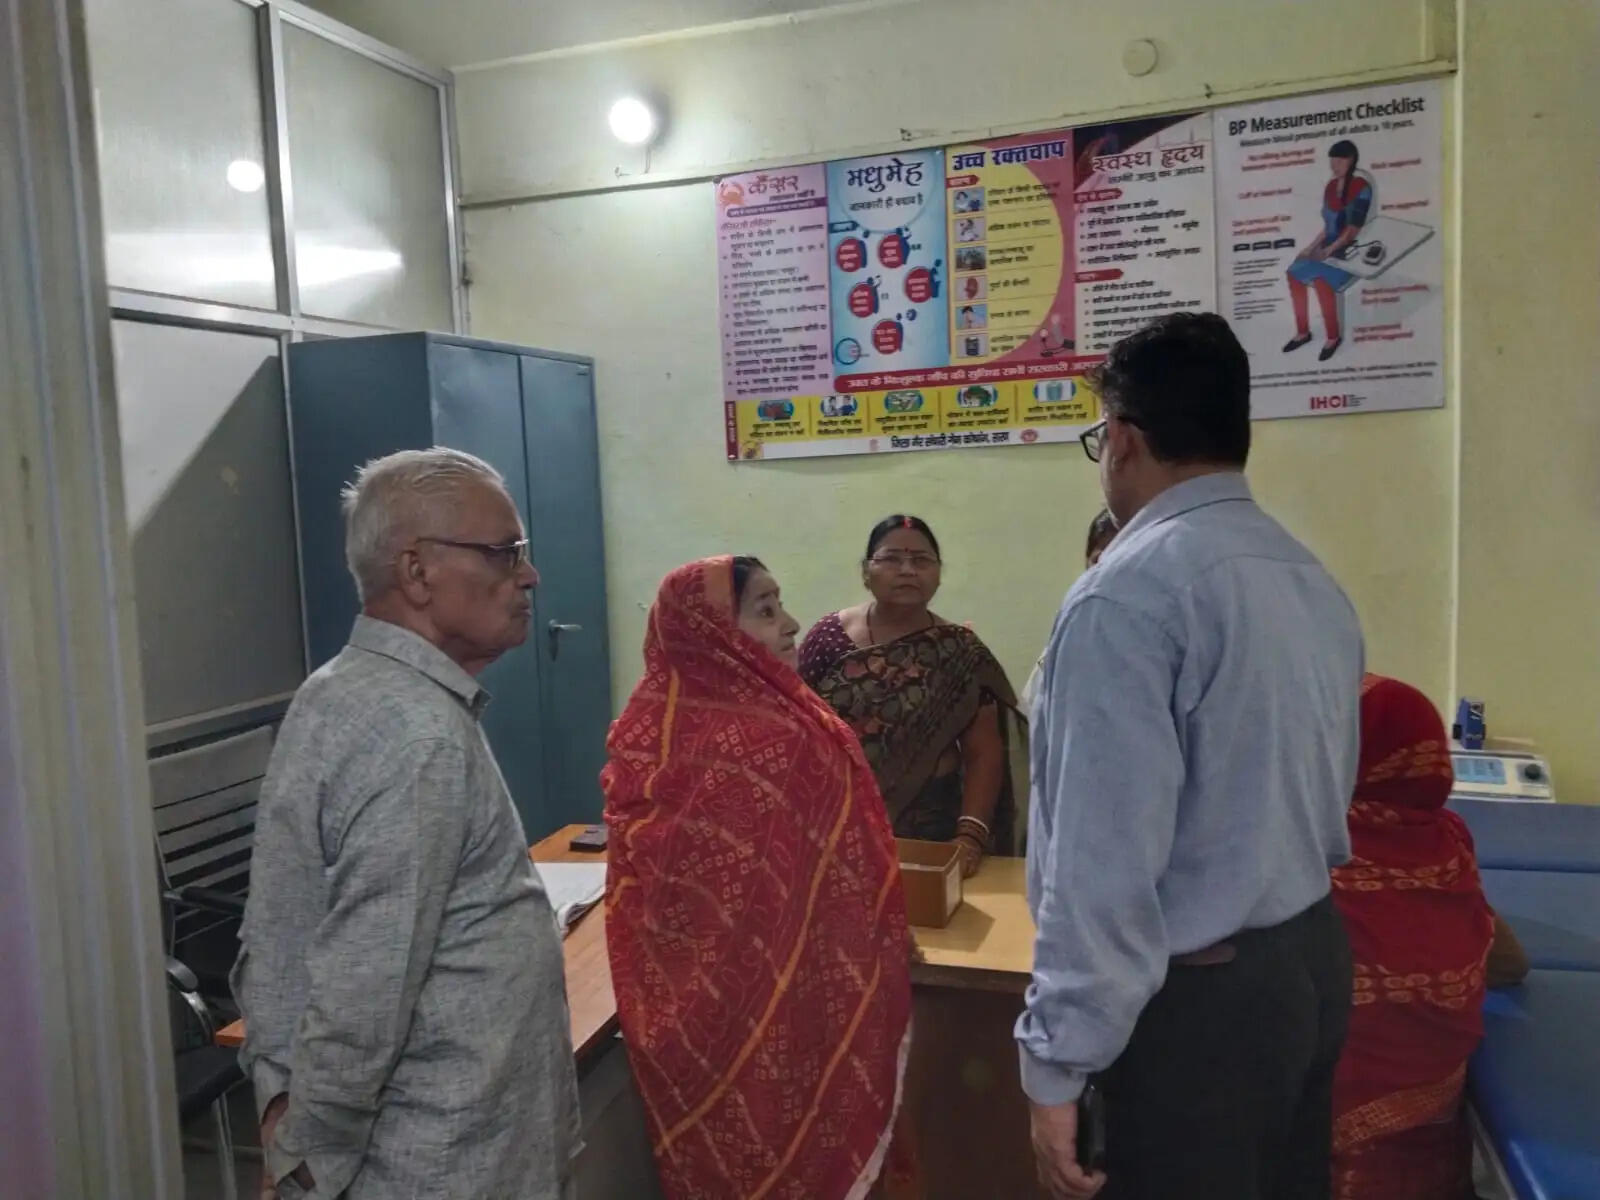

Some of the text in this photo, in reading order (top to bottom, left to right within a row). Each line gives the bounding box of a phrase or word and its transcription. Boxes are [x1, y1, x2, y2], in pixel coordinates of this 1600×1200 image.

[1228, 97, 1425, 136] BP Measurement Checklist
[1240, 135, 1271, 148] Measure
[1273, 132, 1294, 143] blood
[1295, 128, 1329, 142] pressure
[951, 139, 1067, 171] उच्च रक्तचाप
[1092, 144, 1205, 172] स्वस्थ हृदय
[847, 157, 924, 193] मधुमेह
[848, 197, 883, 211] जानकारी
[885, 196, 894, 209] ही
[917, 191, 924, 205] है
[1309, 393, 1349, 411] IHCI
